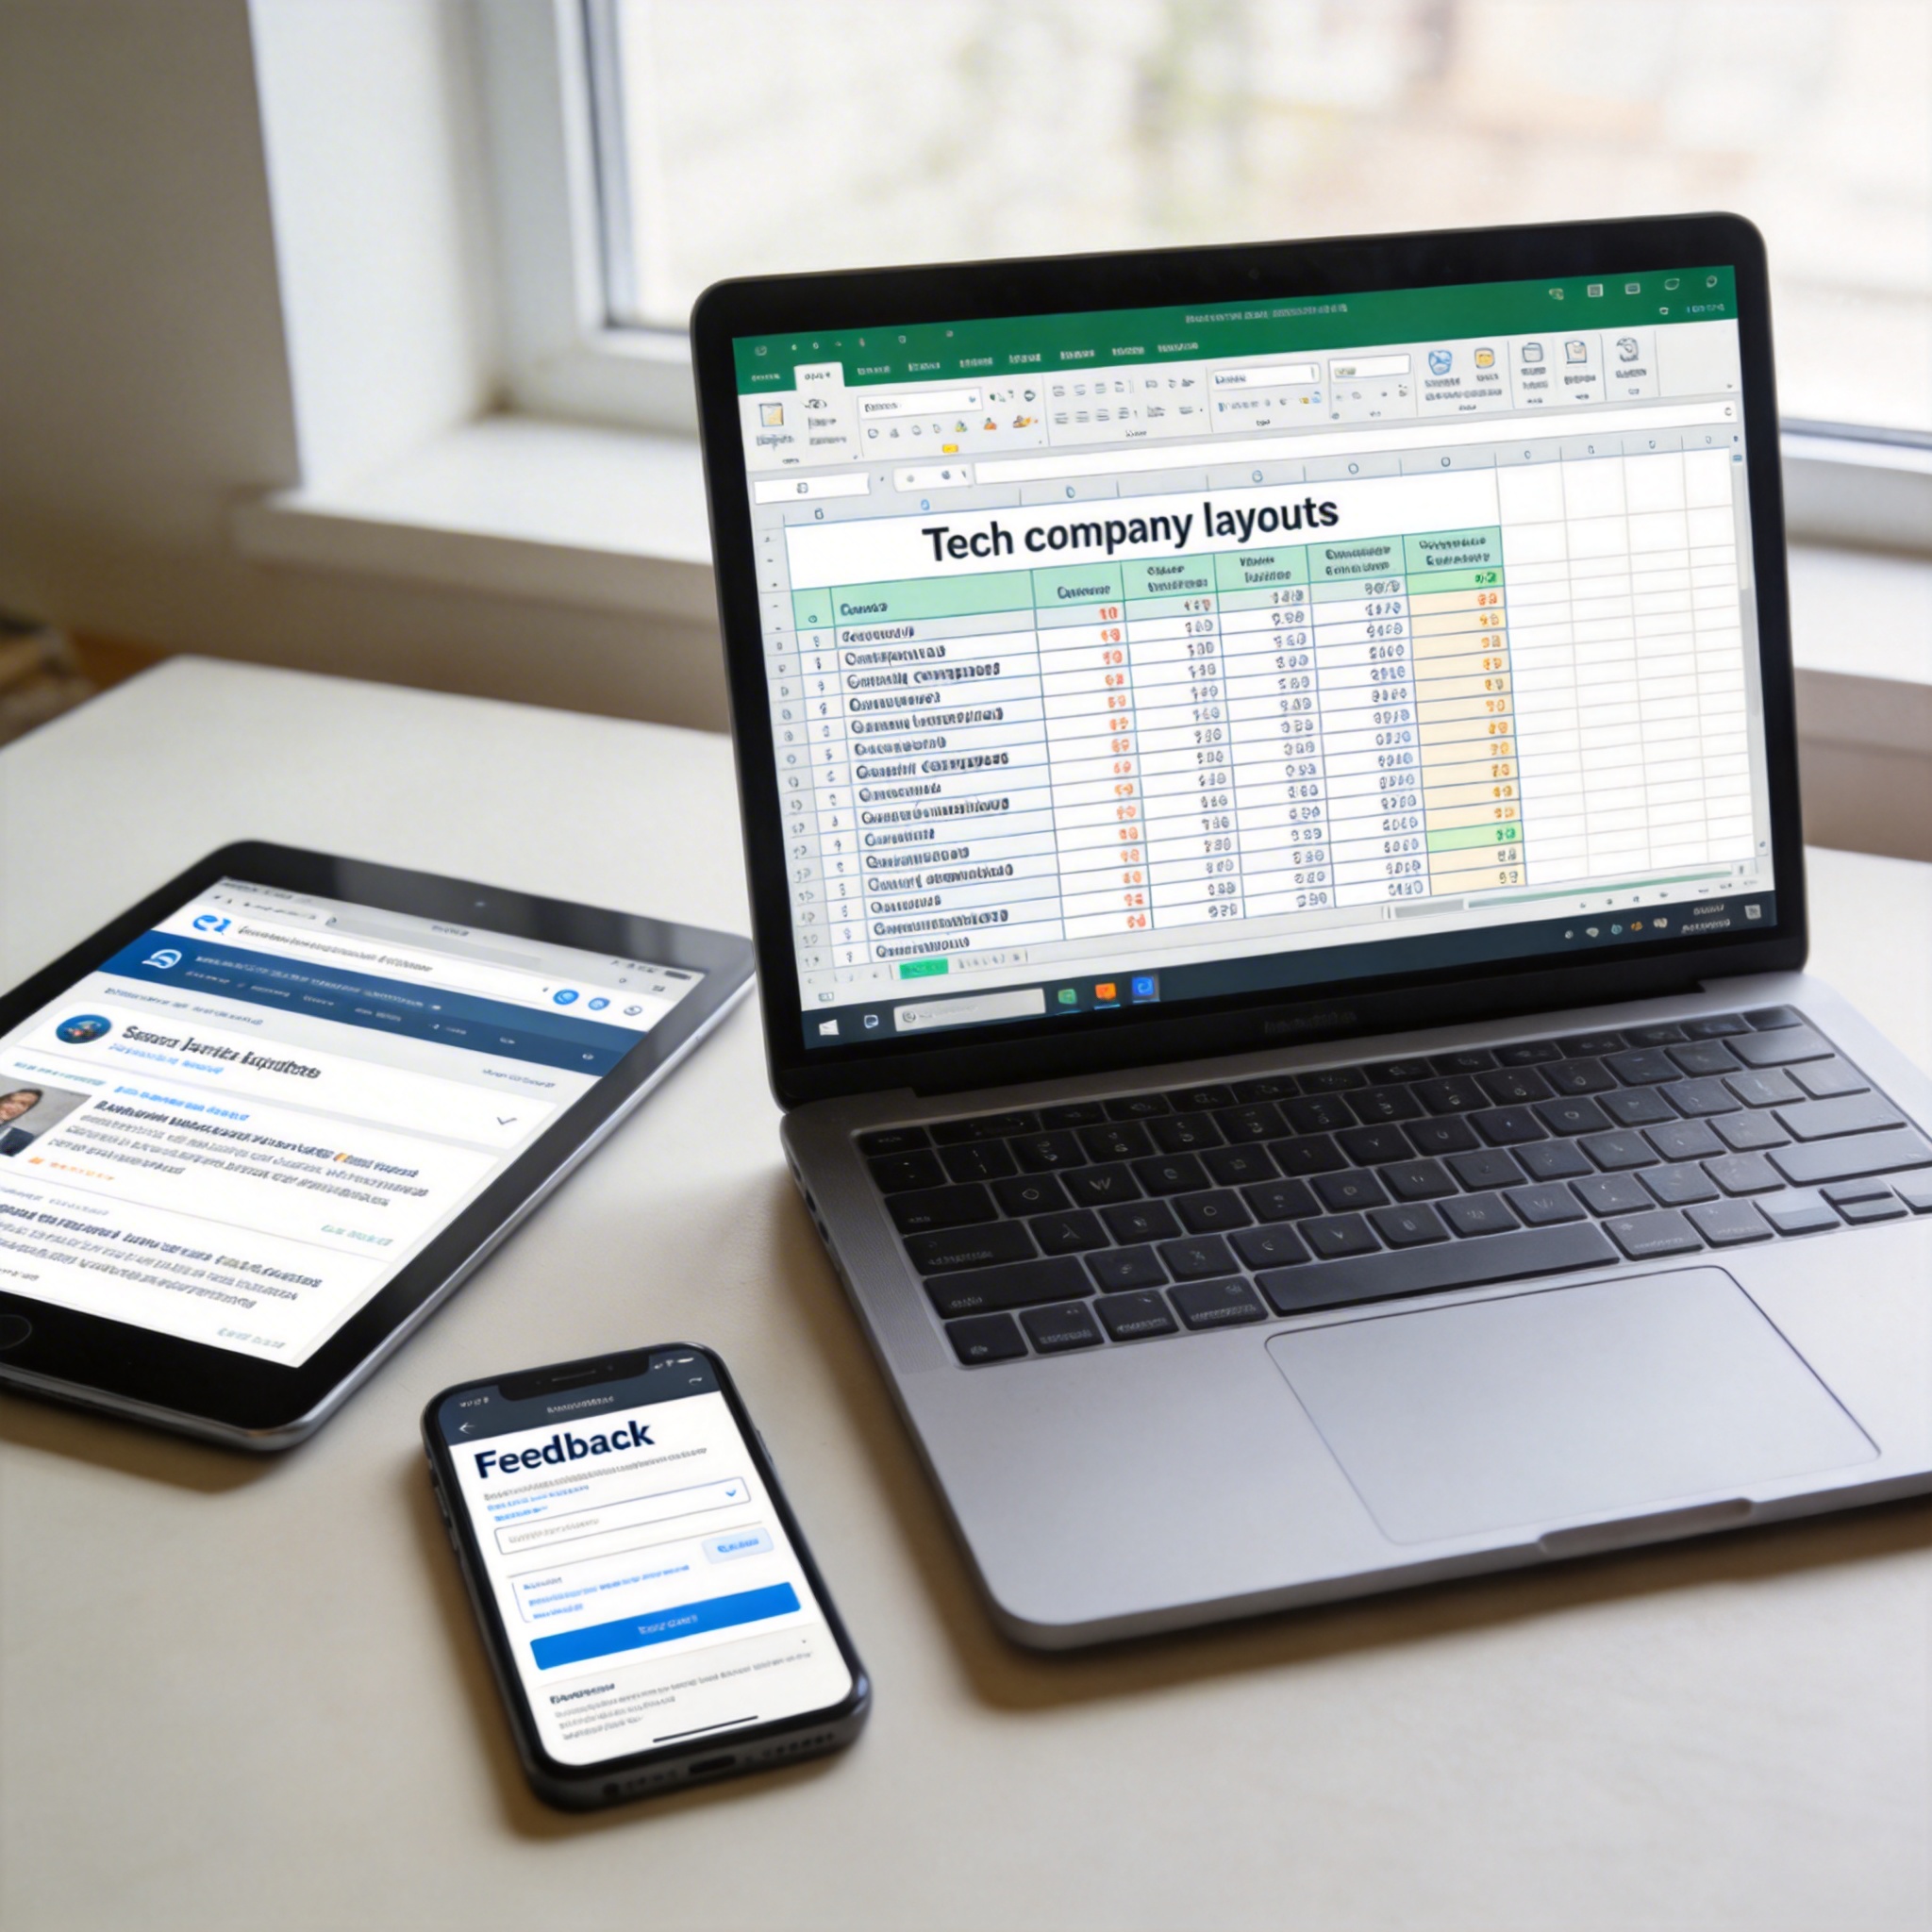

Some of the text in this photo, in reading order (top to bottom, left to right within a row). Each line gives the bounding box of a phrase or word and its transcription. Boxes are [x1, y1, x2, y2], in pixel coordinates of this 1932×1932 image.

[922, 497, 1339, 561] Tech company layouts
[474, 1421, 656, 1479] Feedback
